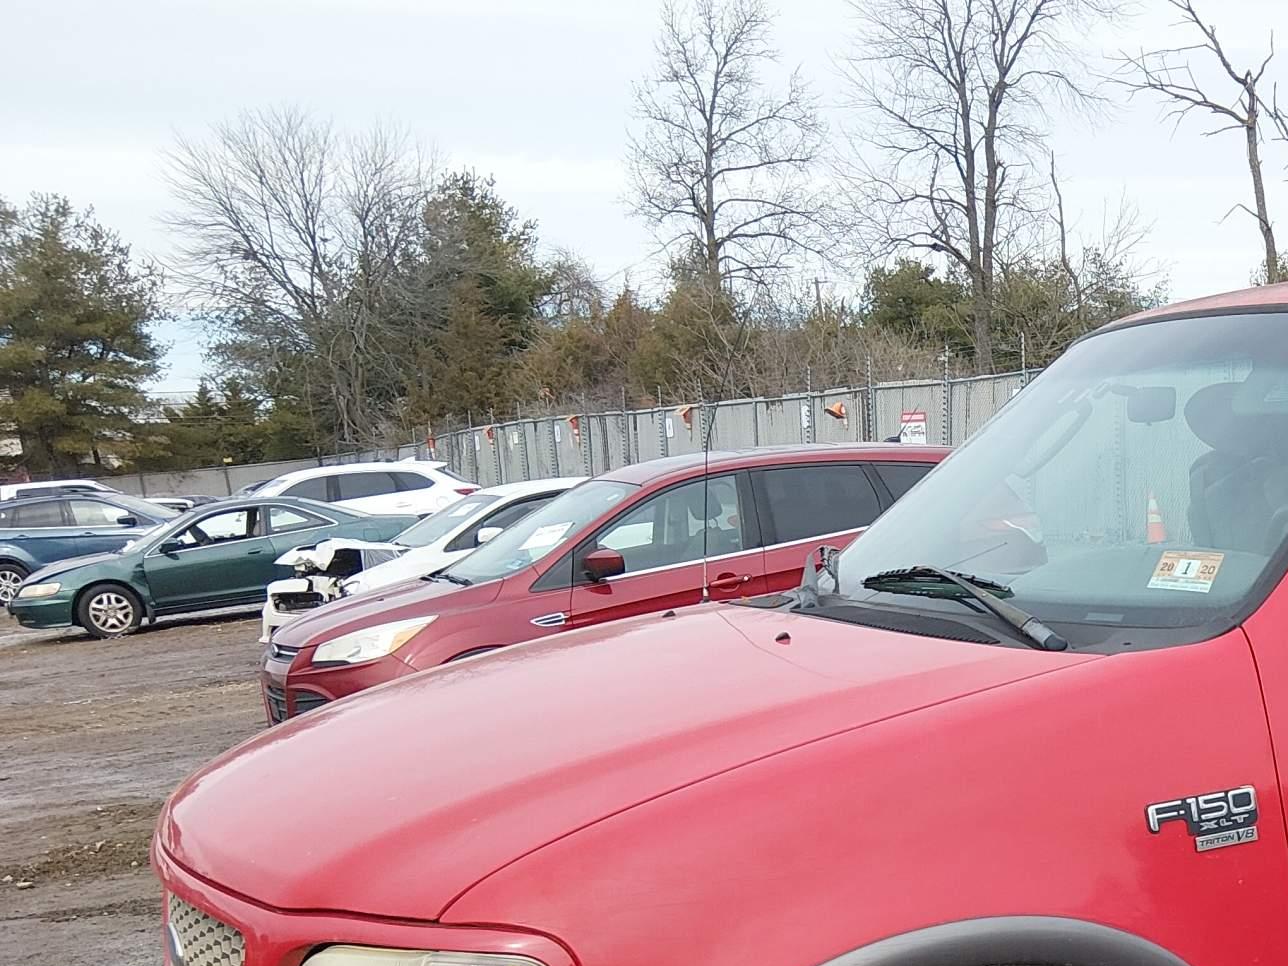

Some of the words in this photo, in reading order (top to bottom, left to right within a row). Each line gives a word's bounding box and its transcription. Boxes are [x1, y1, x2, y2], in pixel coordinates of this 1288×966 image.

[1160, 562, 1175, 572] 20
[1181, 561, 1192, 575] 1
[1199, 565, 1216, 575] 20
[1147, 784, 1255, 832] F-150
[1199, 813, 1250, 831] XLT
[1198, 832, 1235, 847] TRITON
[1235, 828, 1255, 842] V8
